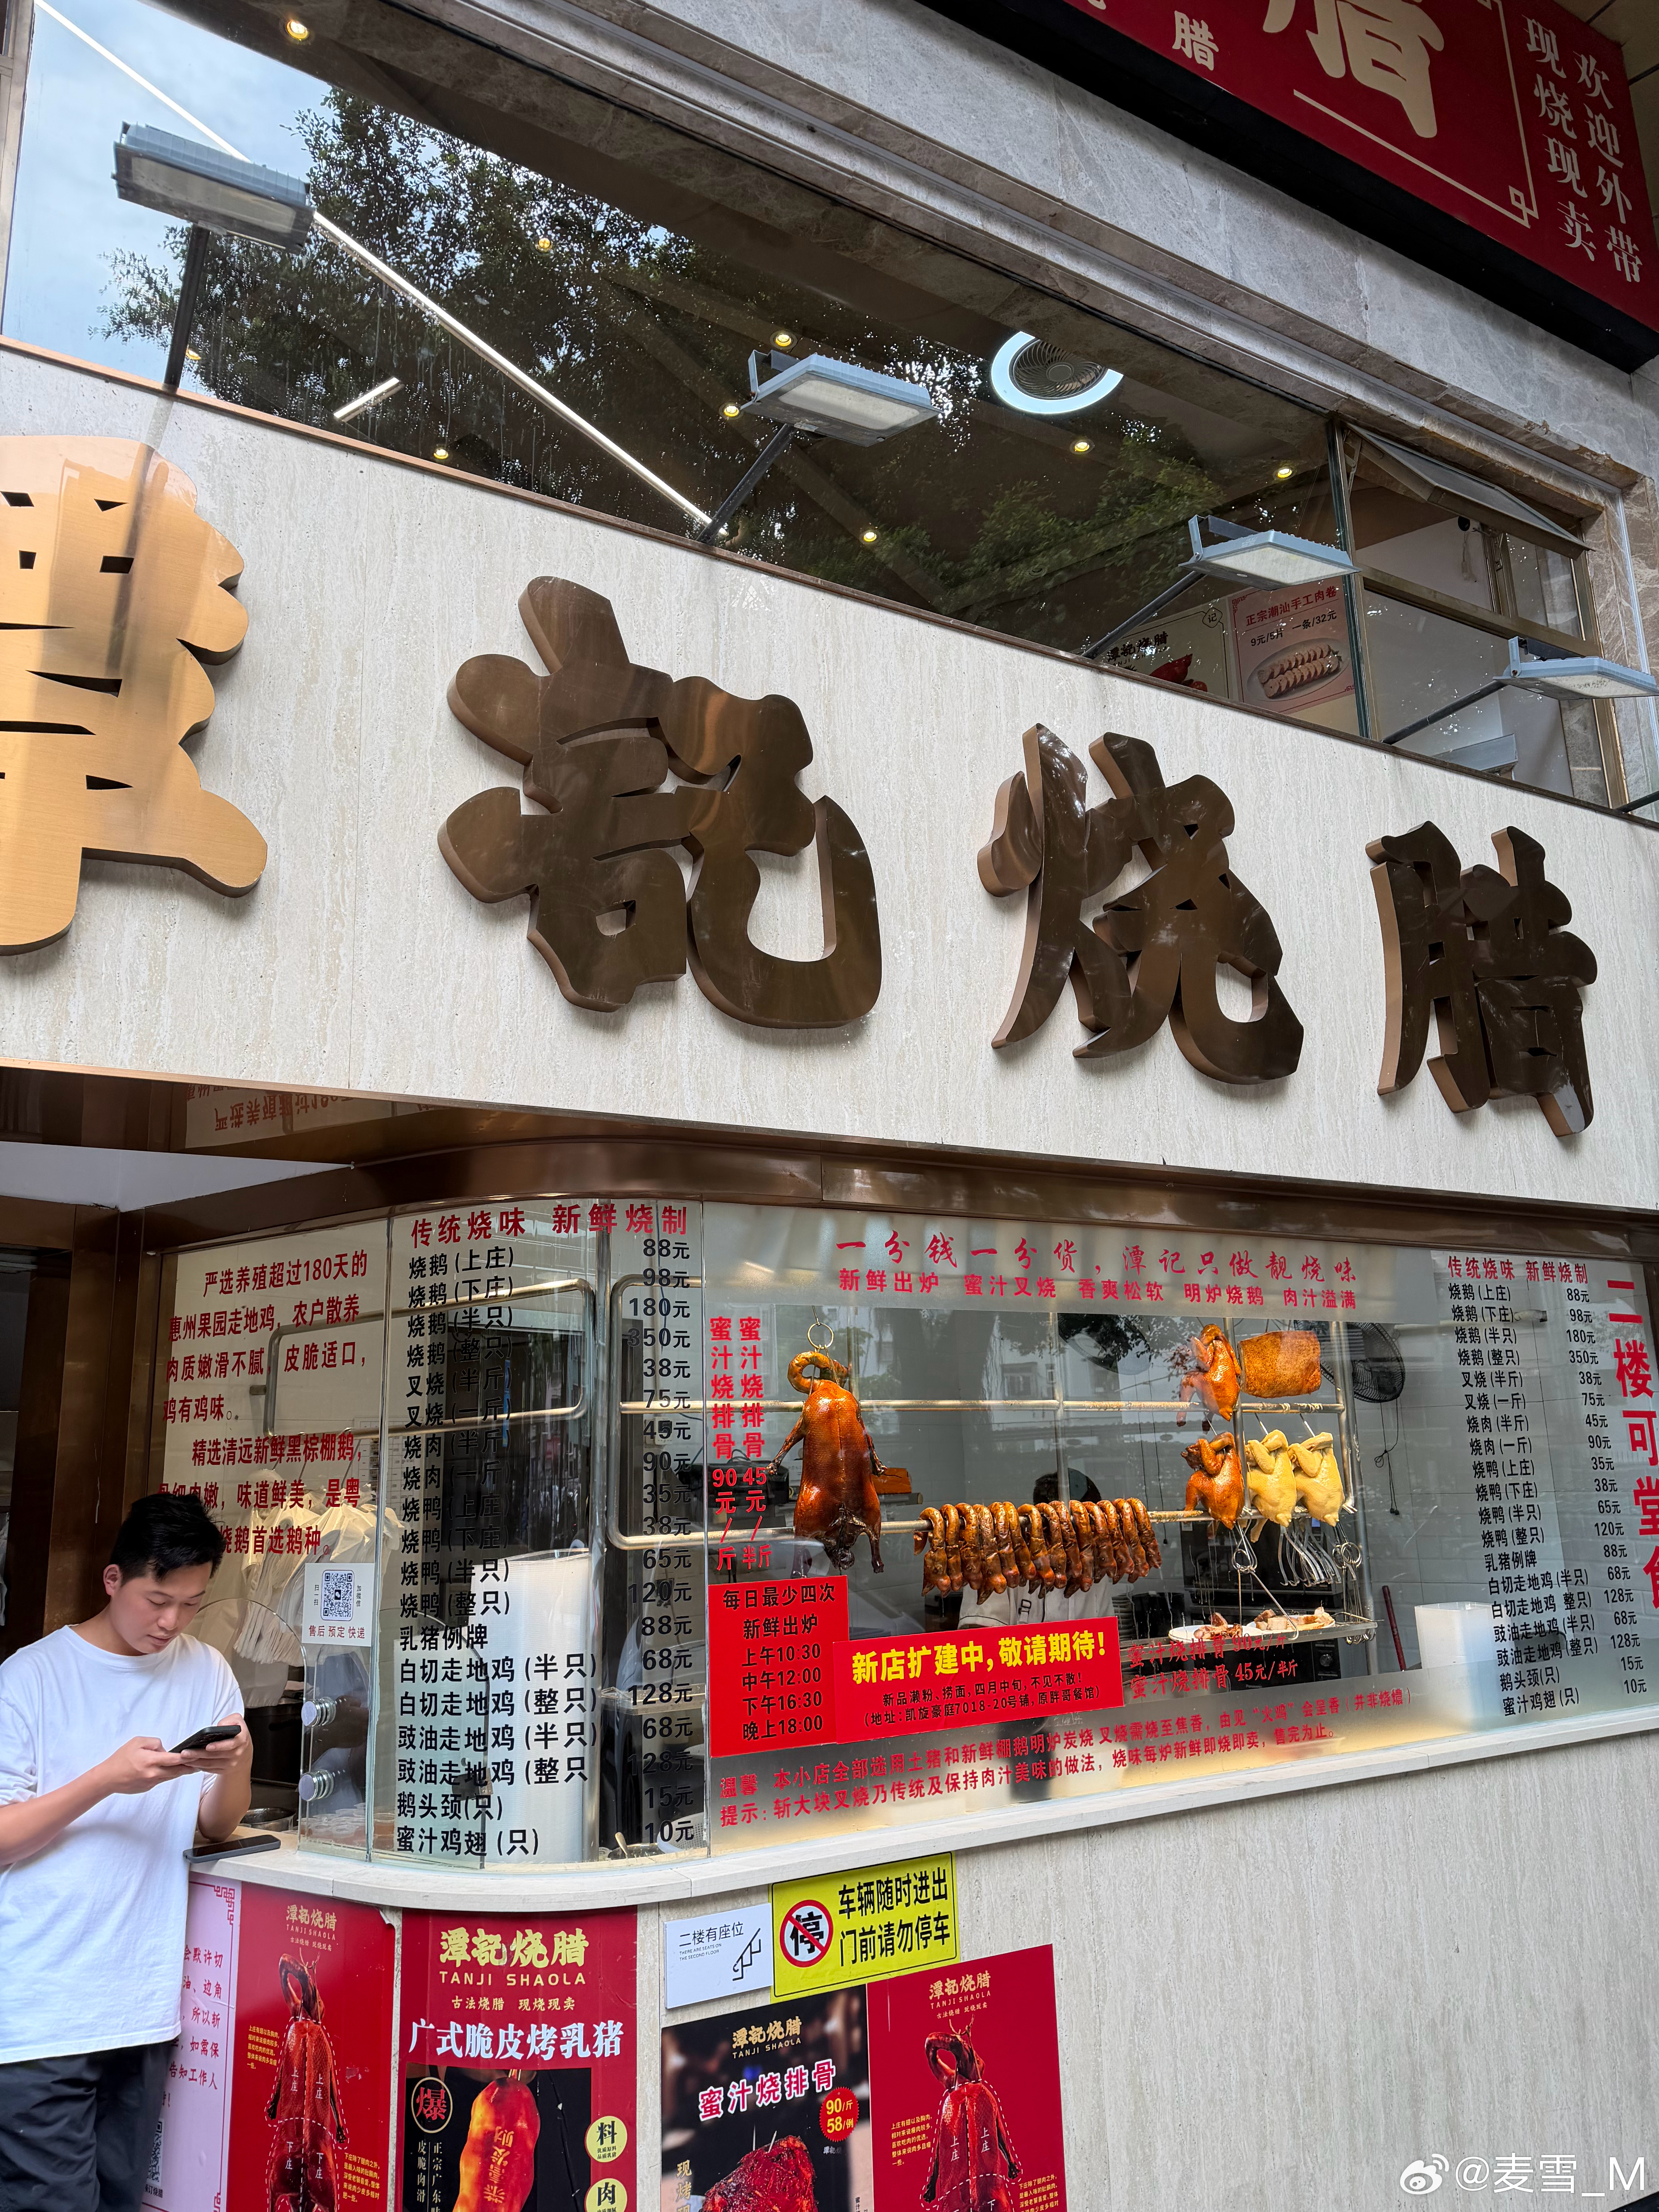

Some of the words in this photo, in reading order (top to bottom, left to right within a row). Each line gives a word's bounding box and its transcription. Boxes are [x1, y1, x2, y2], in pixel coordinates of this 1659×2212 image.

[1522, 14, 1597, 261] 现烧现卖
[1574, 50, 1642, 282] 欢迎外带
[1246, 585, 1338, 626] 正宗潮汕手工肉卷
[411, 1207, 526, 1249] 传统烧味
[552, 1203, 688, 1235] 新鲜烧制
[643, 1238, 690, 1260] 88元
[203, 1249, 367, 1298] 严选养殖超过180天的
[1448, 1255, 1515, 1280] 传统烧味
[1526, 1260, 1588, 1284] 新鲜烧制
[839, 1268, 939, 1293] 新鲜出炉
[963, 1273, 1056, 1298] 蜜汁叉烧
[1078, 1278, 1164, 1301] 香爽松软
[1184, 1283, 1264, 1306] 明炉烧鹅
[1283, 1287, 1356, 1309] 肉汁溢满
[1567, 1288, 1590, 1302] 88元
[630, 1297, 690, 1319] 180元
[1570, 1309, 1592, 1323] 98元
[643, 1358, 691, 1379] 38元
[1570, 1350, 1599, 1364] 350元
[1579, 1372, 1602, 1385] 38元
[162, 1394, 232, 1424] 鸡有鸡味。
[644, 1389, 691, 1410] 75元
[1585, 1413, 1608, 1427] 45元
[1588, 1435, 1611, 1449] 90元
[643, 1451, 691, 1472] 90元
[643, 1484, 691, 1504] 35元
[1594, 1479, 1617, 1492] 38元
[1595, 1522, 1624, 1536] 120元
[1484, 1550, 1537, 1572] 乳猪例牌
[1603, 1544, 1627, 1558] 88元
[1607, 1566, 1630, 1581] 68元
[723, 1582, 836, 1610] 每日最少四次
[309, 1625, 325, 1637] 售后
[328, 1626, 345, 1638] 预定
[348, 1626, 365, 1639] 快递
[400, 1624, 488, 1651] 乳猪例牌
[743, 1613, 818, 1640] 新鲜出炉
[1127, 1635, 1226, 1668] 蜜汁烧排骨
[1610, 1633, 1640, 1650] 128元
[643, 1648, 693, 1671] 68元
[742, 1643, 821, 1667] 上午10:30
[1621, 1656, 1644, 1671] 15元
[742, 1667, 821, 1692] 中午12:00
[1130, 1664, 1228, 1699] 蜜汁烧排骨
[1624, 1679, 1647, 1694] 10元
[628, 1682, 693, 1706] 128元
[742, 1691, 823, 1716] 下午16:30
[643, 1716, 693, 1739] 68元
[742, 1715, 823, 1741] 晚上18:00
[720, 1773, 757, 1799] 温馨
[645, 1819, 694, 1843] 10元
[838, 1867, 948, 1920] 车辆随时进出
[287, 1924, 306, 1934] TANJI
[309, 1929, 335, 1940] SHAOLA
[679, 1921, 744, 1947] 二楼有座位
[790, 1911, 824, 1956] 停
[840, 1911, 949, 1967] 门前请勿停车
[440, 1971, 492, 1985] TANJI
[507, 1972, 586, 1986] SHAOLA
[452, 1995, 504, 2011] 古法烧腊
[518, 1996, 575, 2012] 现烧现卖
[931, 1998, 955, 2009] TANJI
[959, 1990, 991, 2002] SHAOLA
[409, 2018, 623, 2061] 广式脆皮烤乳猪
[733, 2049, 759, 2059] TANJI
[766, 2037, 801, 2051] SHAOLA
[290, 2066, 299, 2092] 上庄
[315, 2073, 323, 2100] 上庄
[699, 2059, 836, 2121] 蜜汁烧排骨
[416, 2087, 447, 2121] 爆
[826, 2098, 853, 2115] 90/斤
[596, 2121, 617, 2145] 料
[827, 2116, 854, 2133] 58/例
[950, 2135, 960, 2162] 上庄
[981, 2127, 990, 2152] 上庄
[285, 2142, 293, 2169] 下庄
[315, 2153, 324, 2179] 下庄
[598, 2182, 616, 2206] 肉
